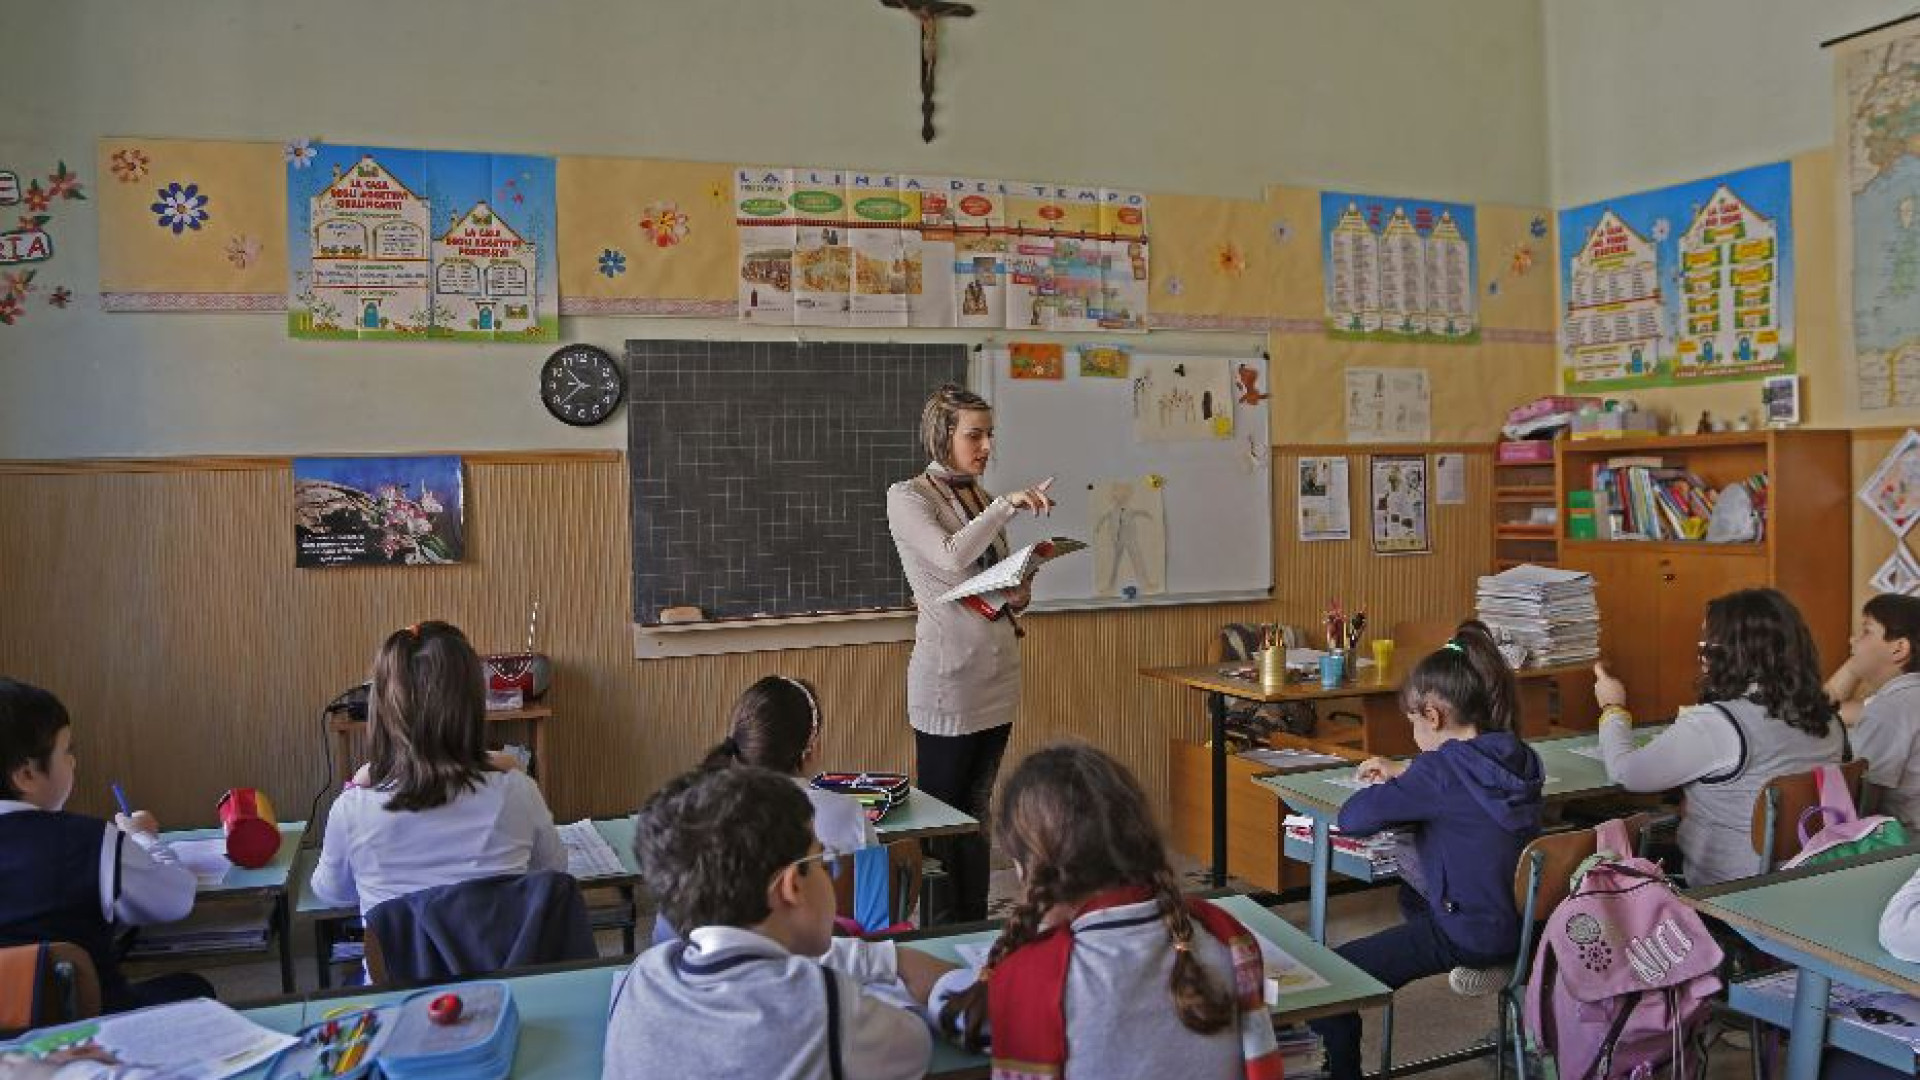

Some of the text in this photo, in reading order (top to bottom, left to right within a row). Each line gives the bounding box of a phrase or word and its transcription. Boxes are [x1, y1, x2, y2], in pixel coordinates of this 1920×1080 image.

[740, 170, 1143, 205] LA LINEA DEL TEMPO
[561, 357, 573, 367] 11
[574, 353, 588, 363] 12
[552, 367, 563, 377] 10
[602, 367, 610, 377] 2
[563, 404, 571, 414] 7
